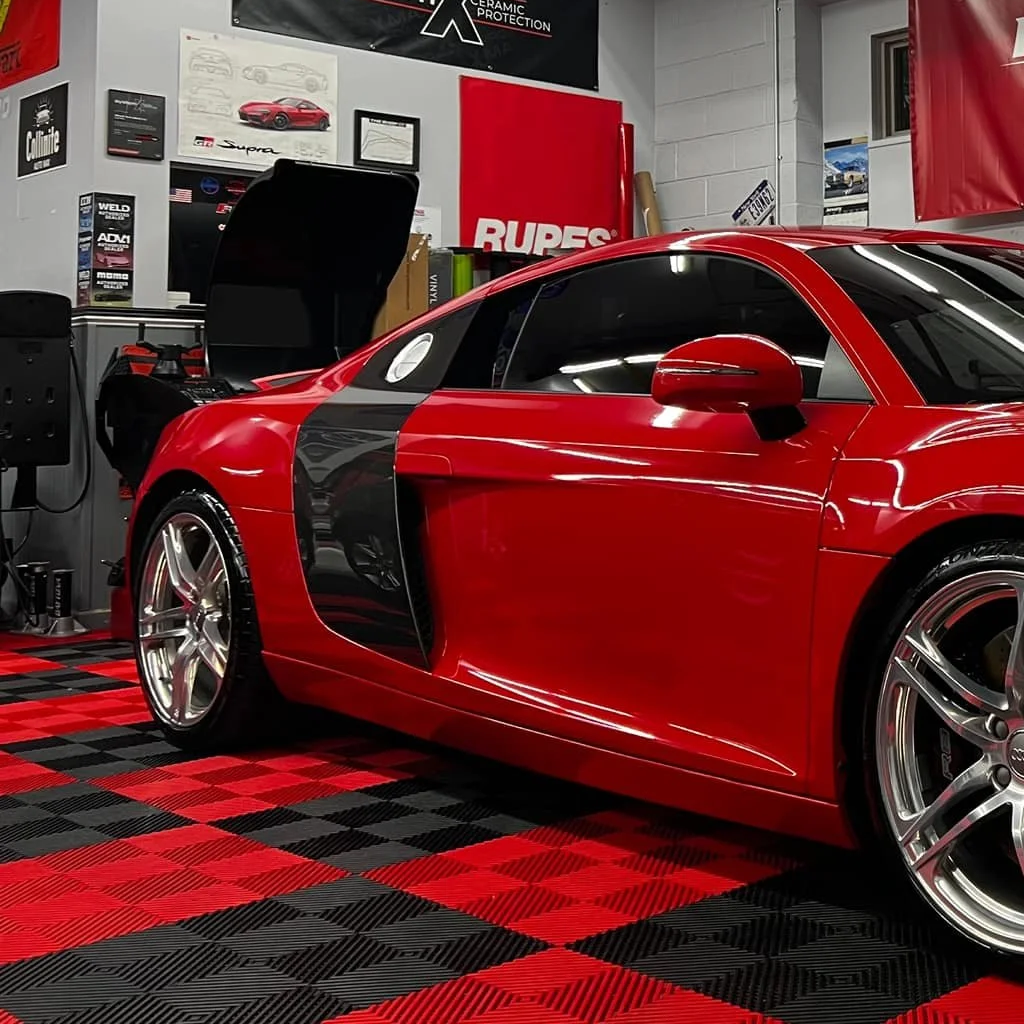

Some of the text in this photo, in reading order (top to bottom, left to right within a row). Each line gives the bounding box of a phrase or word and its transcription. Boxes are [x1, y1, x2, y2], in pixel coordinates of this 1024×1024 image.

[477, 7, 551, 32] PROTECTION
[26, 126, 60, 163] Collinite
[217, 139, 281, 155] Supra
[98, 202, 131, 212] WELD
[429, 274, 438, 304] VINYL
